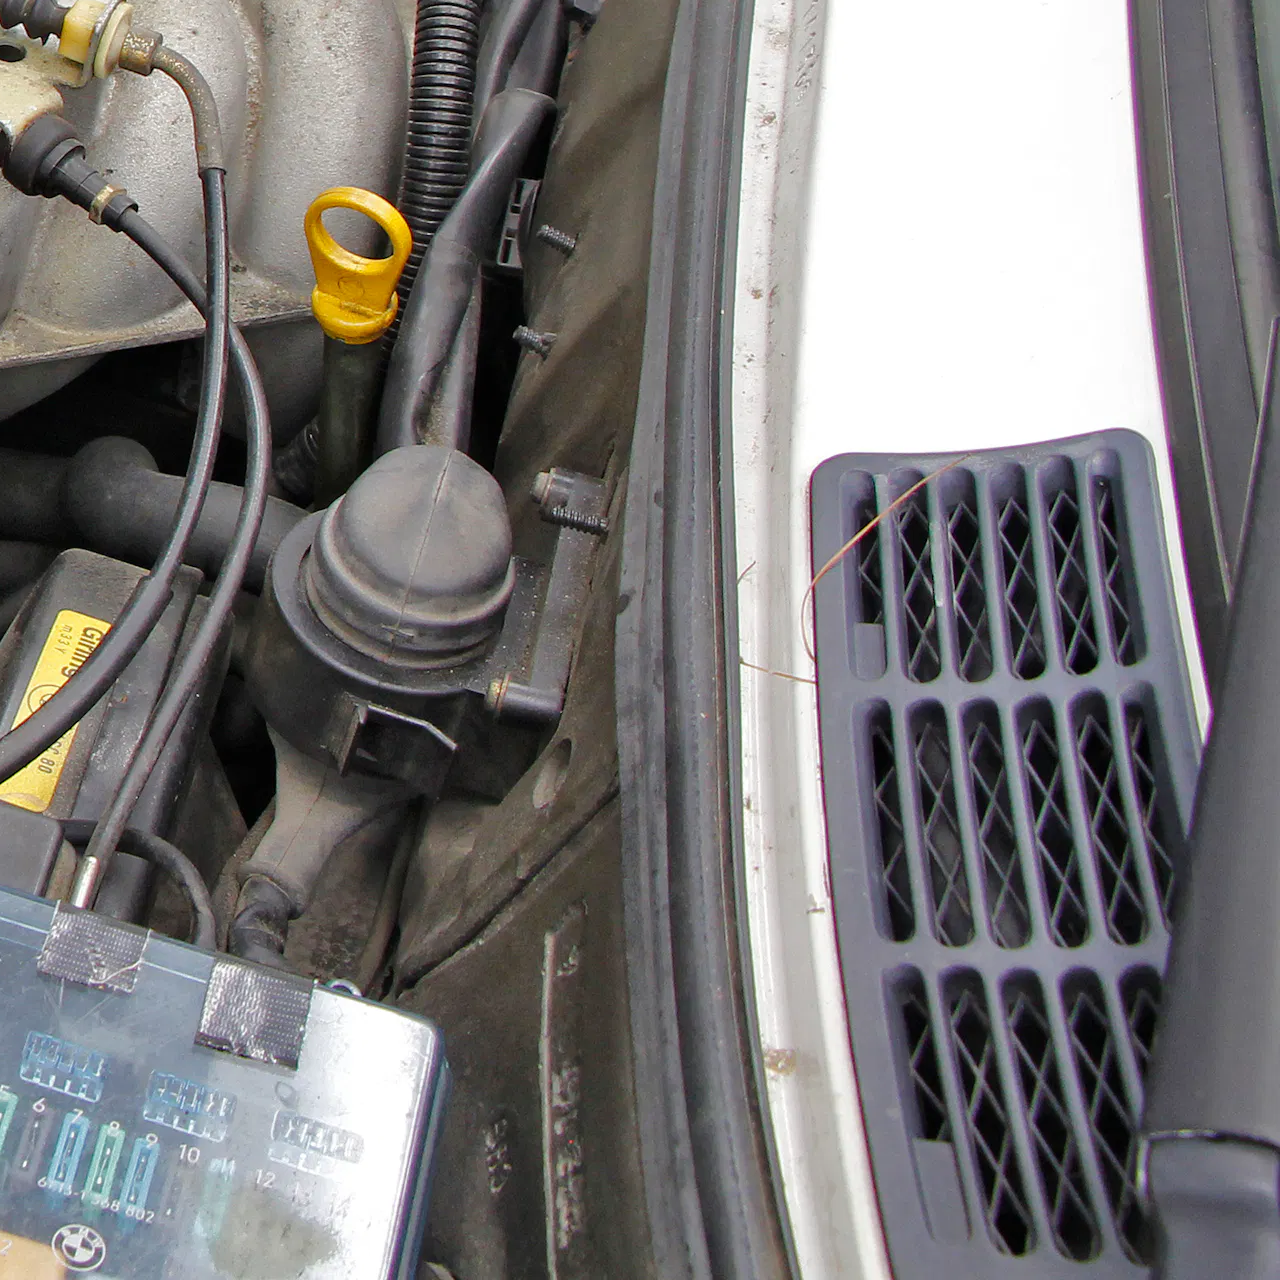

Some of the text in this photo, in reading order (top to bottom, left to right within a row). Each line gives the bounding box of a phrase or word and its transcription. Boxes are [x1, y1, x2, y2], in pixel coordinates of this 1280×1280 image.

[32, 1097, 46, 1113] 6
[71, 1108, 84, 1123] 7
[178, 1143, 201, 1164] 10
[255, 1169, 277, 1189] 12
[125, 1205, 155, 1223] 802
